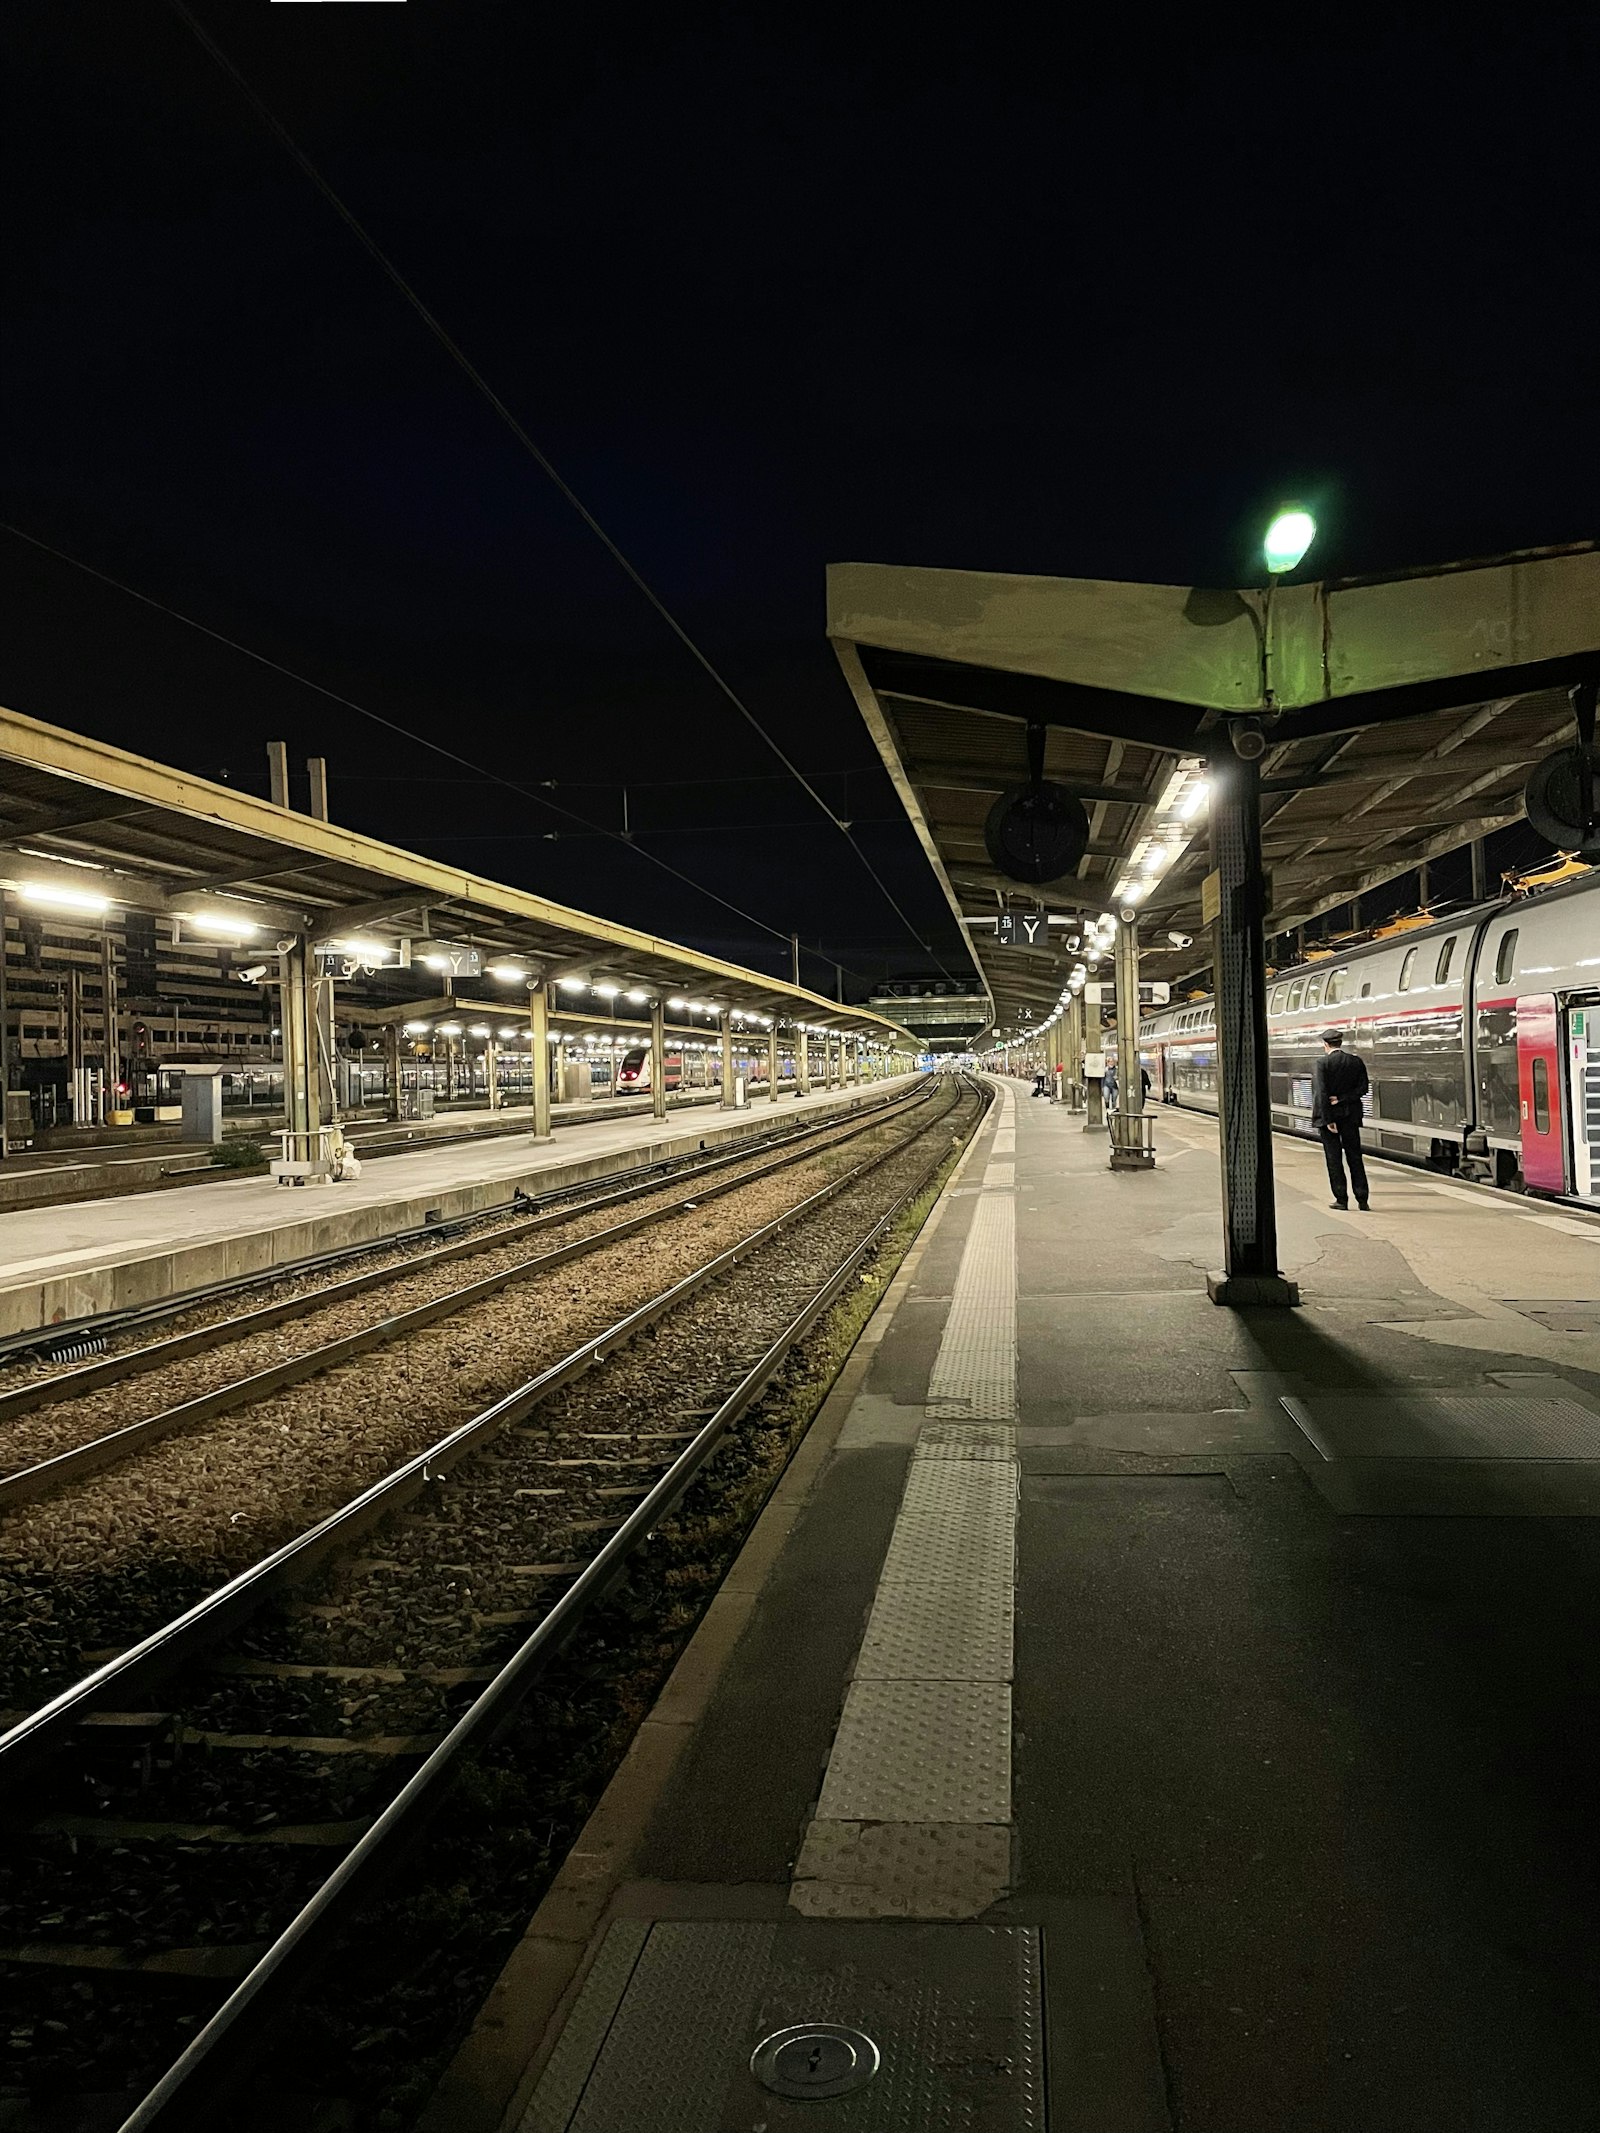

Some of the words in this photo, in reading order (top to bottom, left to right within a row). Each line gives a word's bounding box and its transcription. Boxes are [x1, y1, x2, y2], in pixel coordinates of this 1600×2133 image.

[1002, 919, 1012, 928] 15
[1022, 920, 1040, 943] Y
[449, 956, 463, 975] Y
[1024, 1010, 1032, 1019] X
[737, 1021, 744, 1032] X
[779, 1019, 786, 1028] X
[401, 1028, 410, 1038] X
